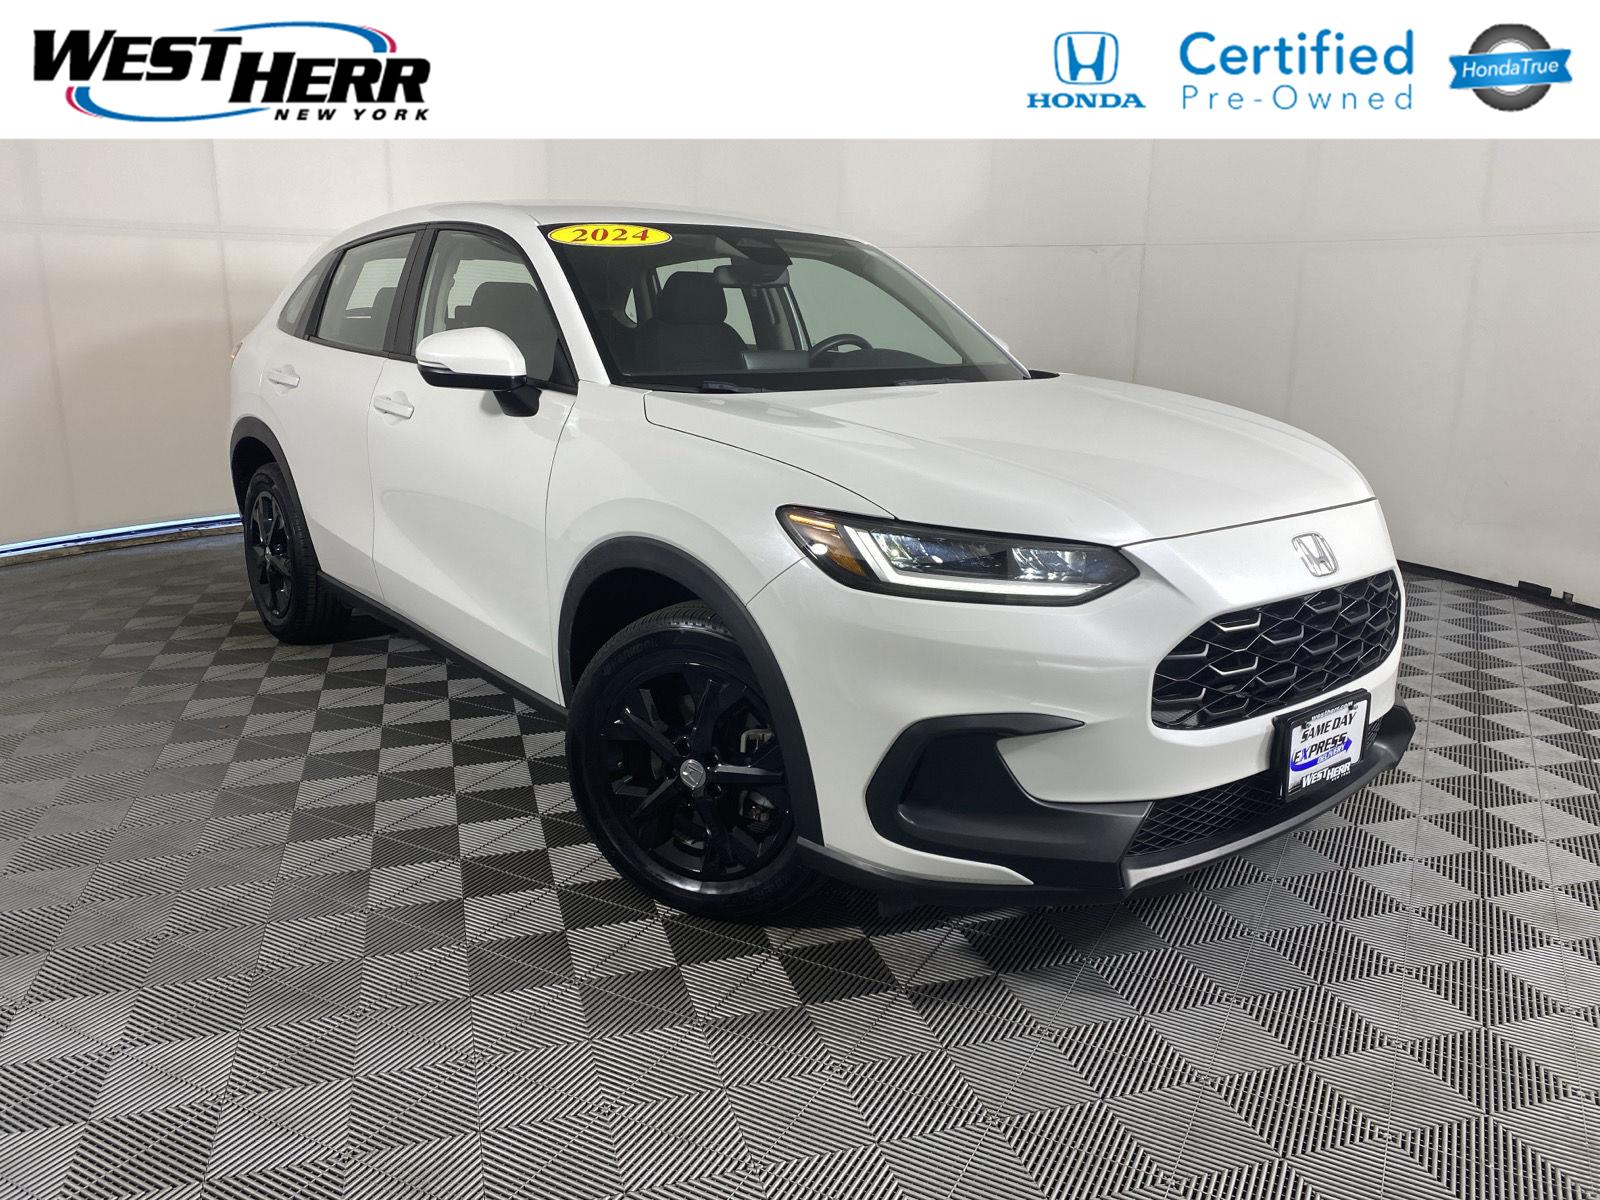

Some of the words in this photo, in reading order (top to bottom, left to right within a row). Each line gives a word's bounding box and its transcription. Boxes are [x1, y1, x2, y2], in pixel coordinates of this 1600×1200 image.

[570, 226, 649, 242] 2024
[1301, 720, 1332, 743] SAME
[1332, 712, 1357, 731] DAY
[1294, 732, 1348, 764] EXPRESS
